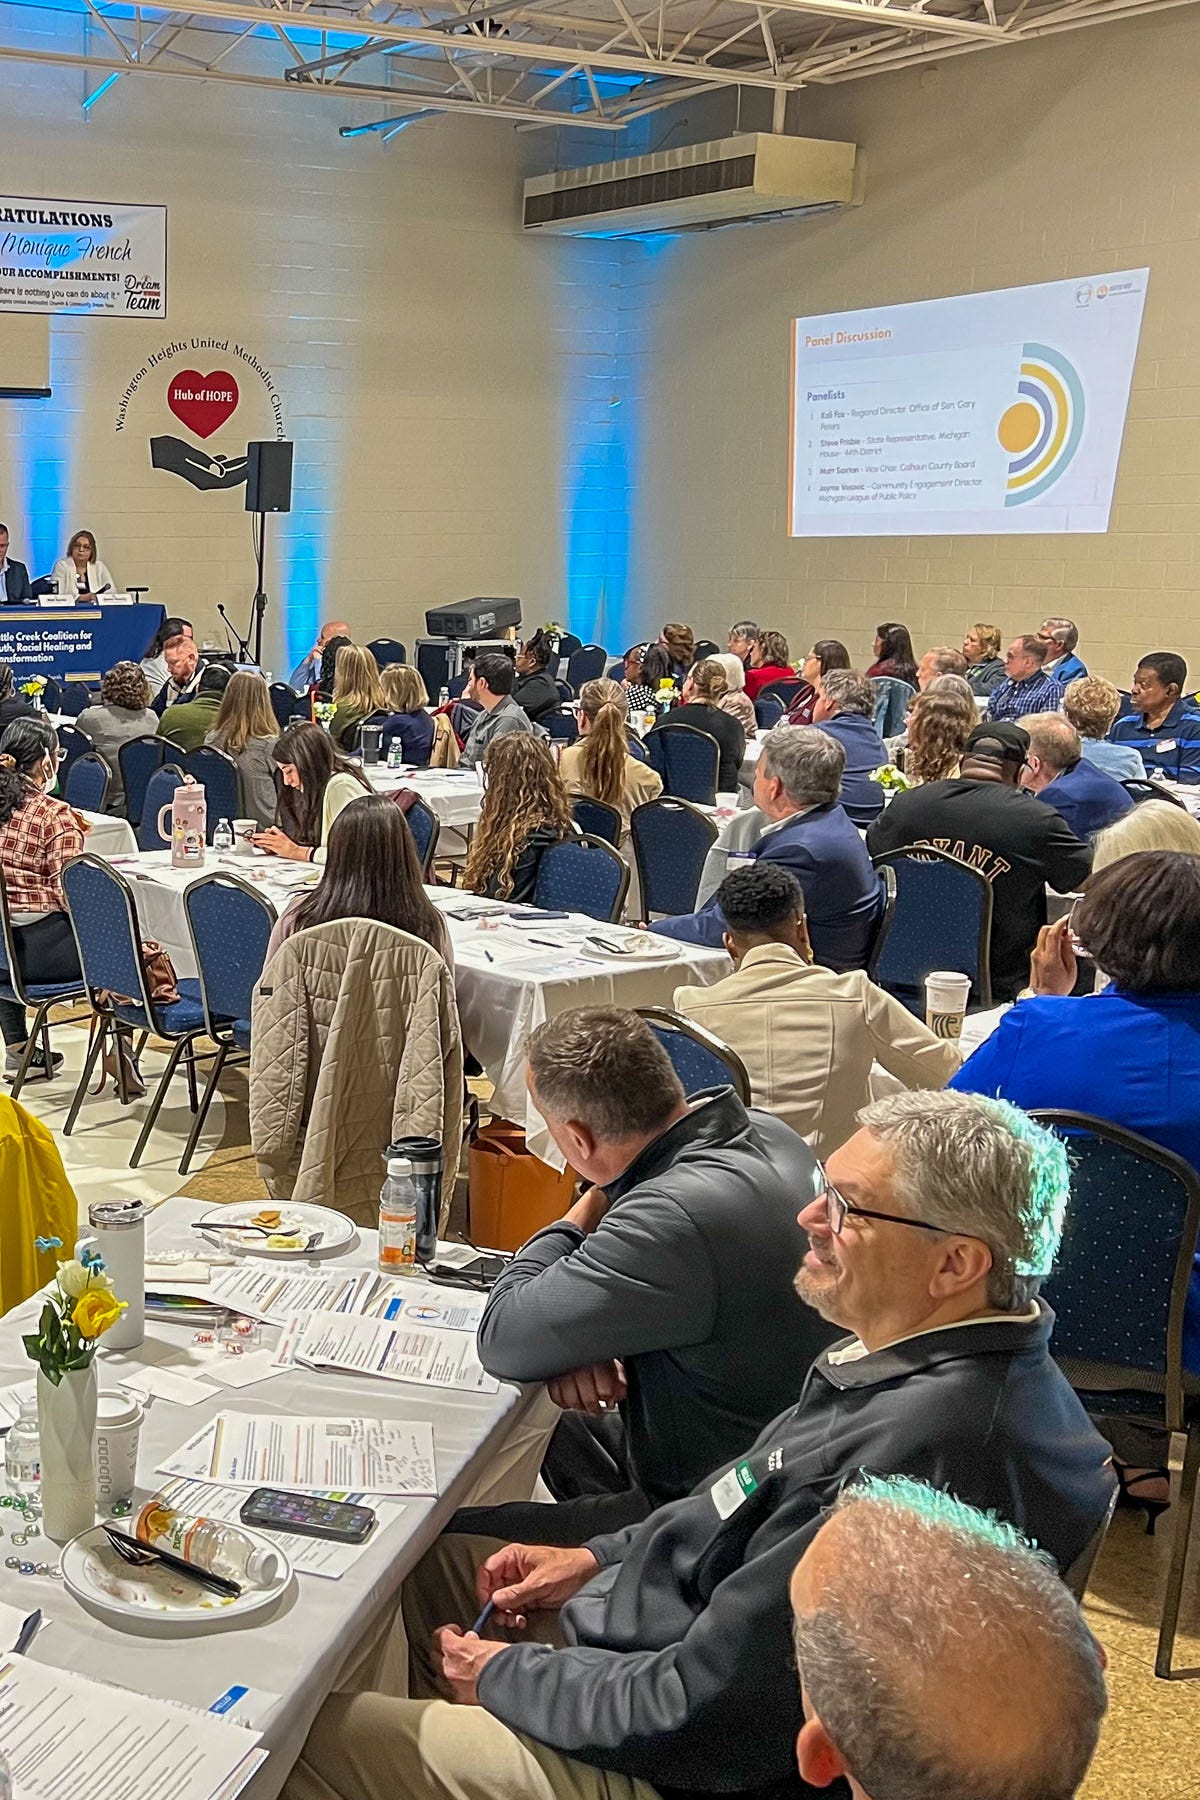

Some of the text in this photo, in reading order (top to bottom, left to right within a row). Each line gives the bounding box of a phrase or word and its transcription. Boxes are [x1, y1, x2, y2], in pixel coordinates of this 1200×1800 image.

[0, 232, 71, 266] Monique
[76, 236, 132, 262] French
[18, 268, 120, 282] ACCOMPLISHMENTS!
[124, 274, 160, 290] Dream
[24, 288, 50, 299] nothing
[51, 290, 65, 299] you
[65, 290, 79, 298] can
[80, 290, 89, 298] do
[90, 290, 110, 299] about
[124, 290, 161, 310] Team
[805, 328, 892, 347] Panel Discussion
[115, 338, 286, 442] Washington Heights United Methodist Church
[174, 389, 233, 402] Hub of HOPE
[807, 390, 845, 402] Panelists
[880, 406, 906, 415] Director
[908, 403, 930, 413] Office
[931, 402, 940, 411] of
[957, 400, 976, 410] Gary
[938, 431, 970, 441] Michigan
[899, 463, 927, 471] Calhoun
[928, 462, 953, 471] County
[954, 460, 976, 469] Board
[954, 478, 983, 487] Director
[15, 631, 40, 642] Creek
[41, 630, 79, 641] Coalition
[80, 630, 92, 640] for
[16, 642, 42, 653] Racial
[42, 641, 75, 654] Healing
[75, 640, 92, 651] and
